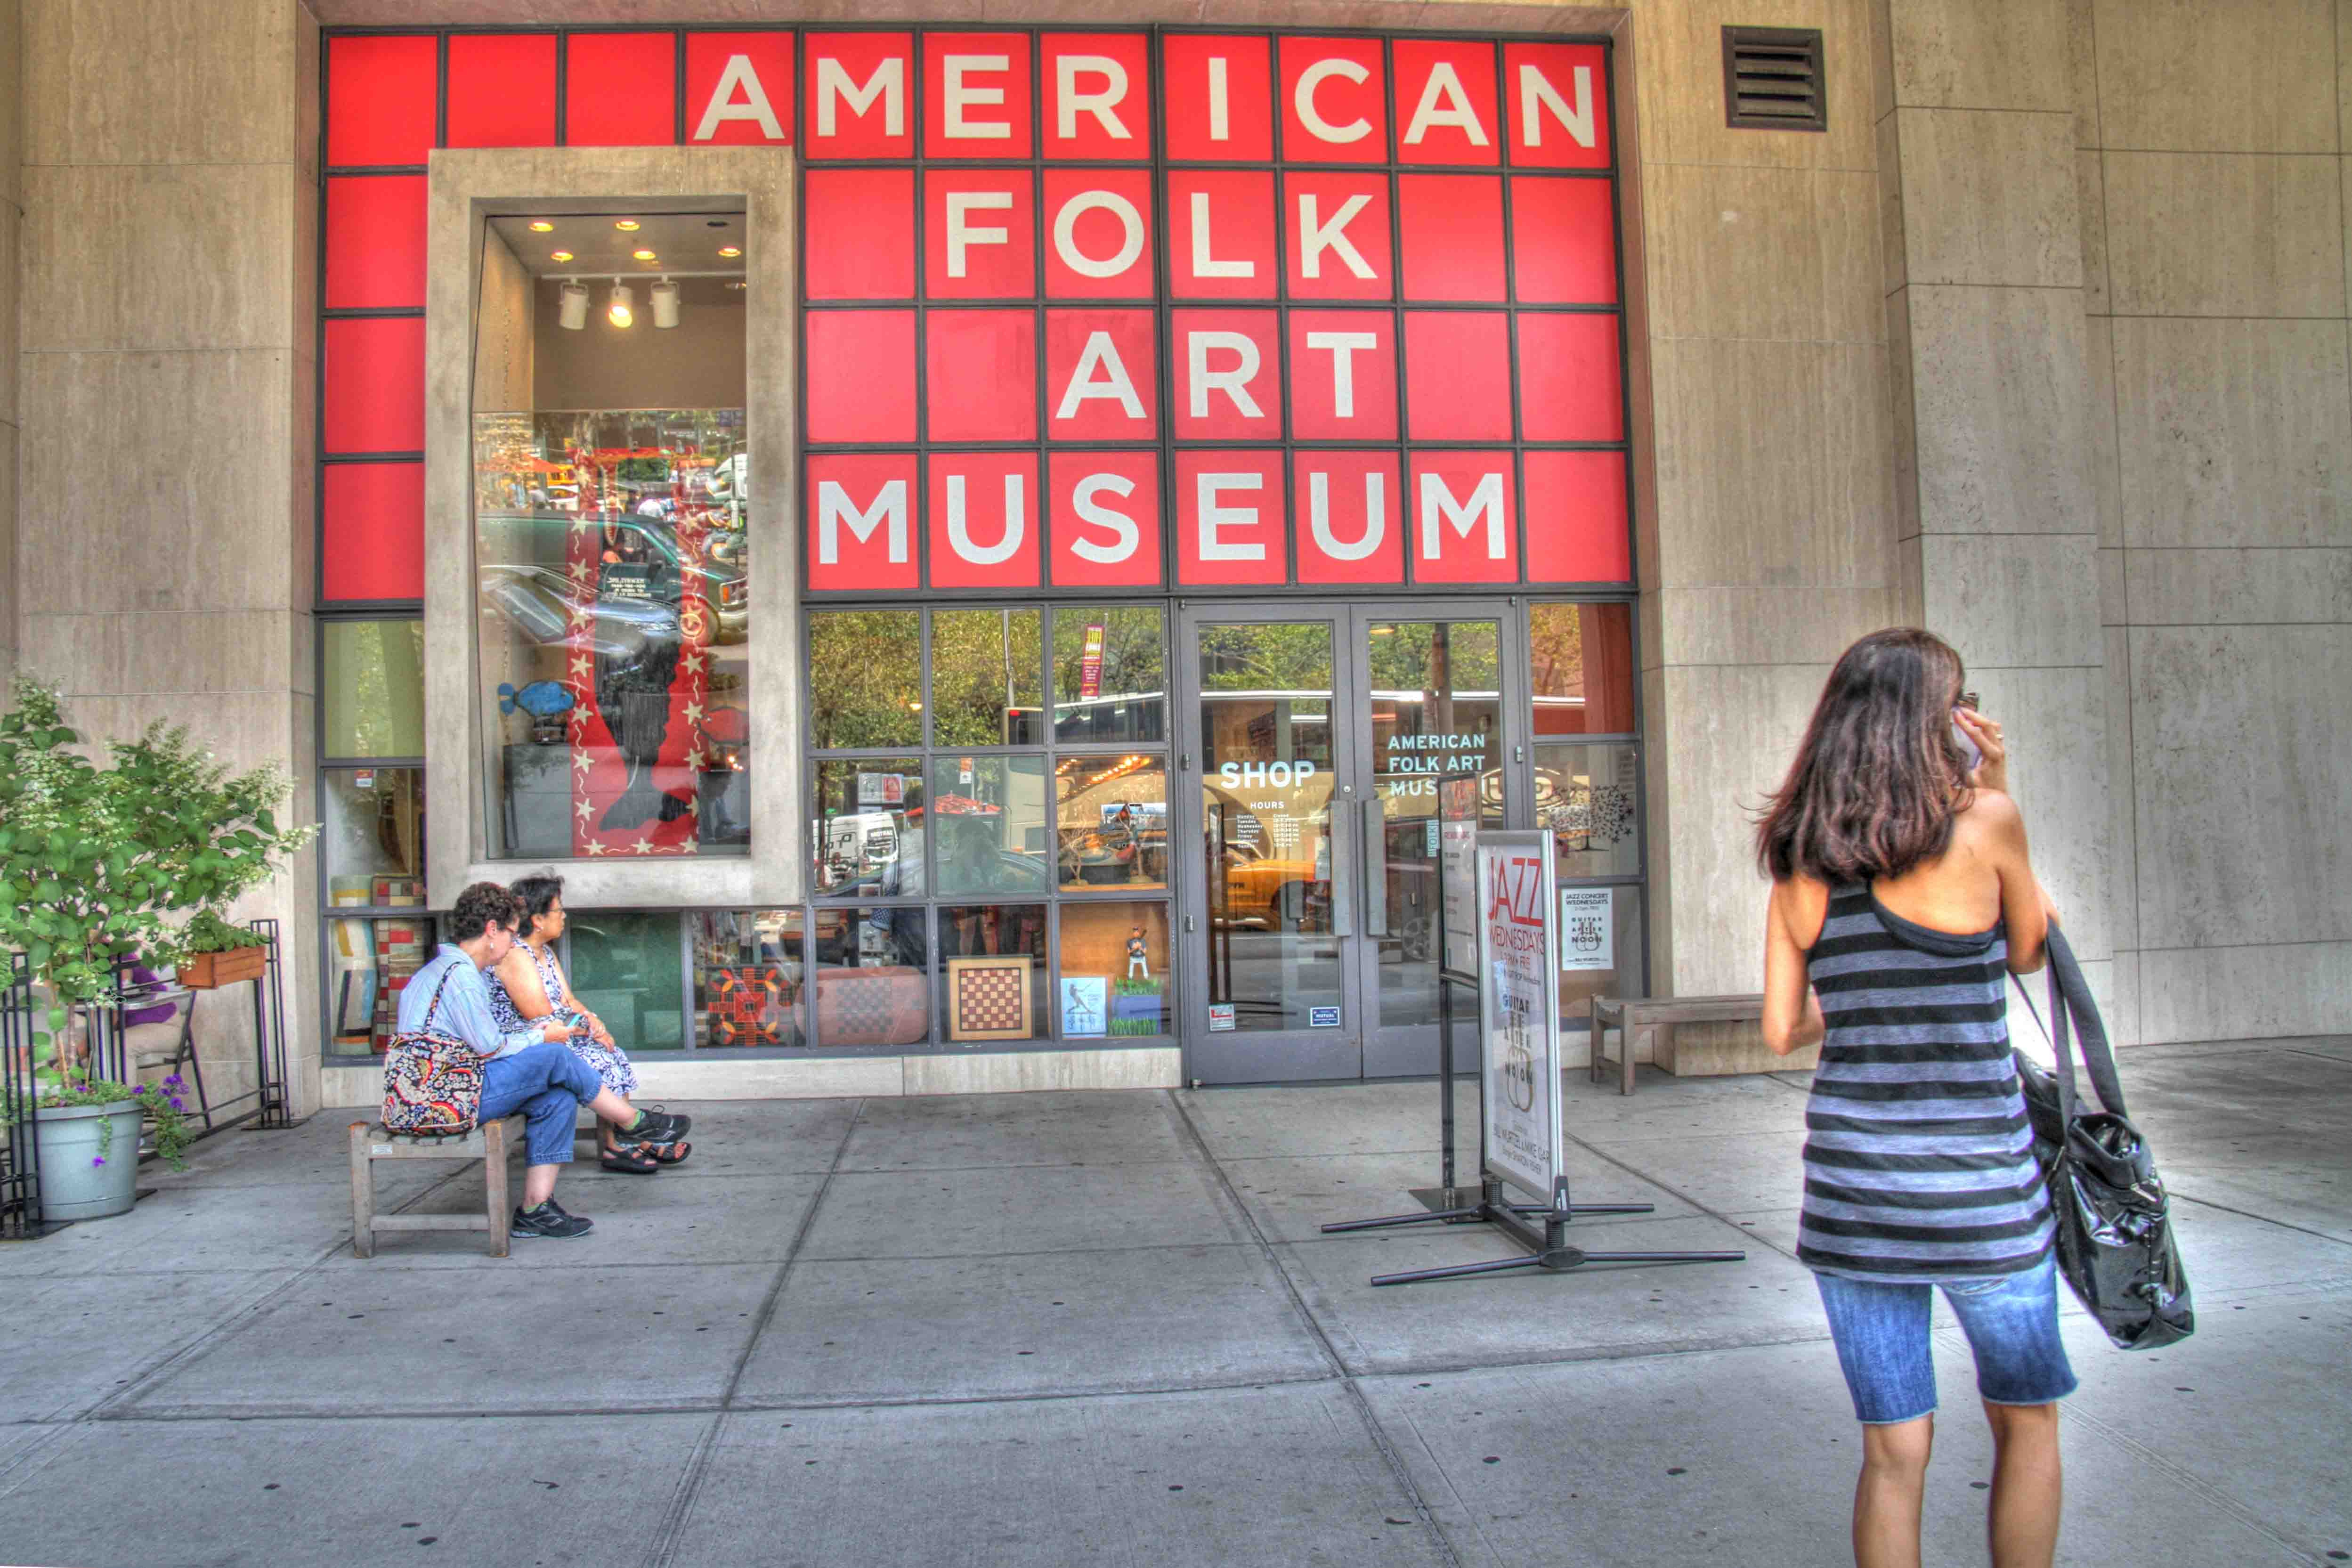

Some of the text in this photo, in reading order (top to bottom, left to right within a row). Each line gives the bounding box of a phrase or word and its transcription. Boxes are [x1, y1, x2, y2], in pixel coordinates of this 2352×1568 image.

[693, 55, 1596, 147] AMERICAN
[946, 190, 1378, 279] FOLK
[1055, 331, 1377, 419] ART
[819, 472, 1506, 564] MUSEUM
[1220, 761, 1315, 789] SHOP
[1388, 734, 1485, 750] AMERICAN
[1389, 755, 1485, 772] FOLK ART
[1250, 801, 1284, 809] HOURS
[1488, 856, 1543, 927] JAZZ
